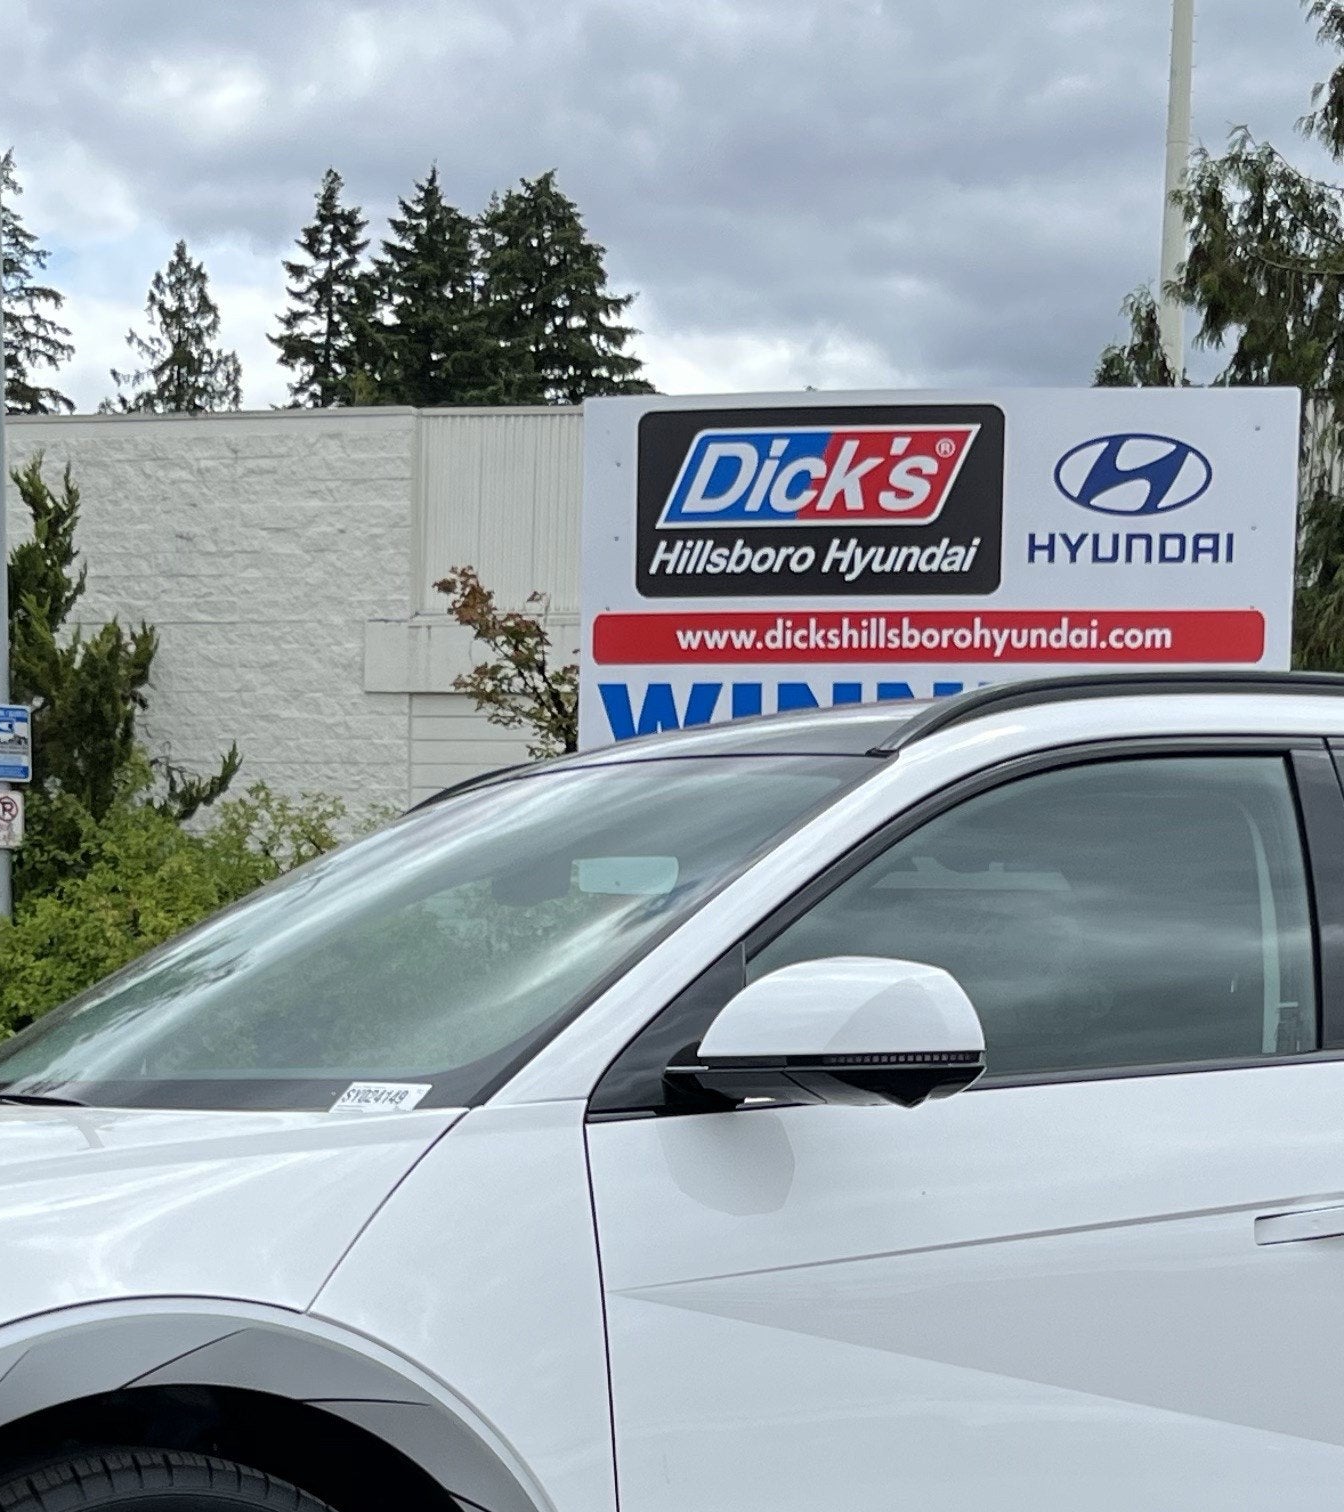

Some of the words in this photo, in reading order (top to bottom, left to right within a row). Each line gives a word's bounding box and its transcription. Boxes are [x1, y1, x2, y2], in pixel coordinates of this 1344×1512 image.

[680, 436, 940, 513] Dick's
[649, 538, 815, 574] Hillsboro
[821, 537, 981, 582] Hyundai
[1027, 532, 1234, 564] HYUNDAI
[676, 616, 1173, 658] www.dickshillsborohyundai.com
